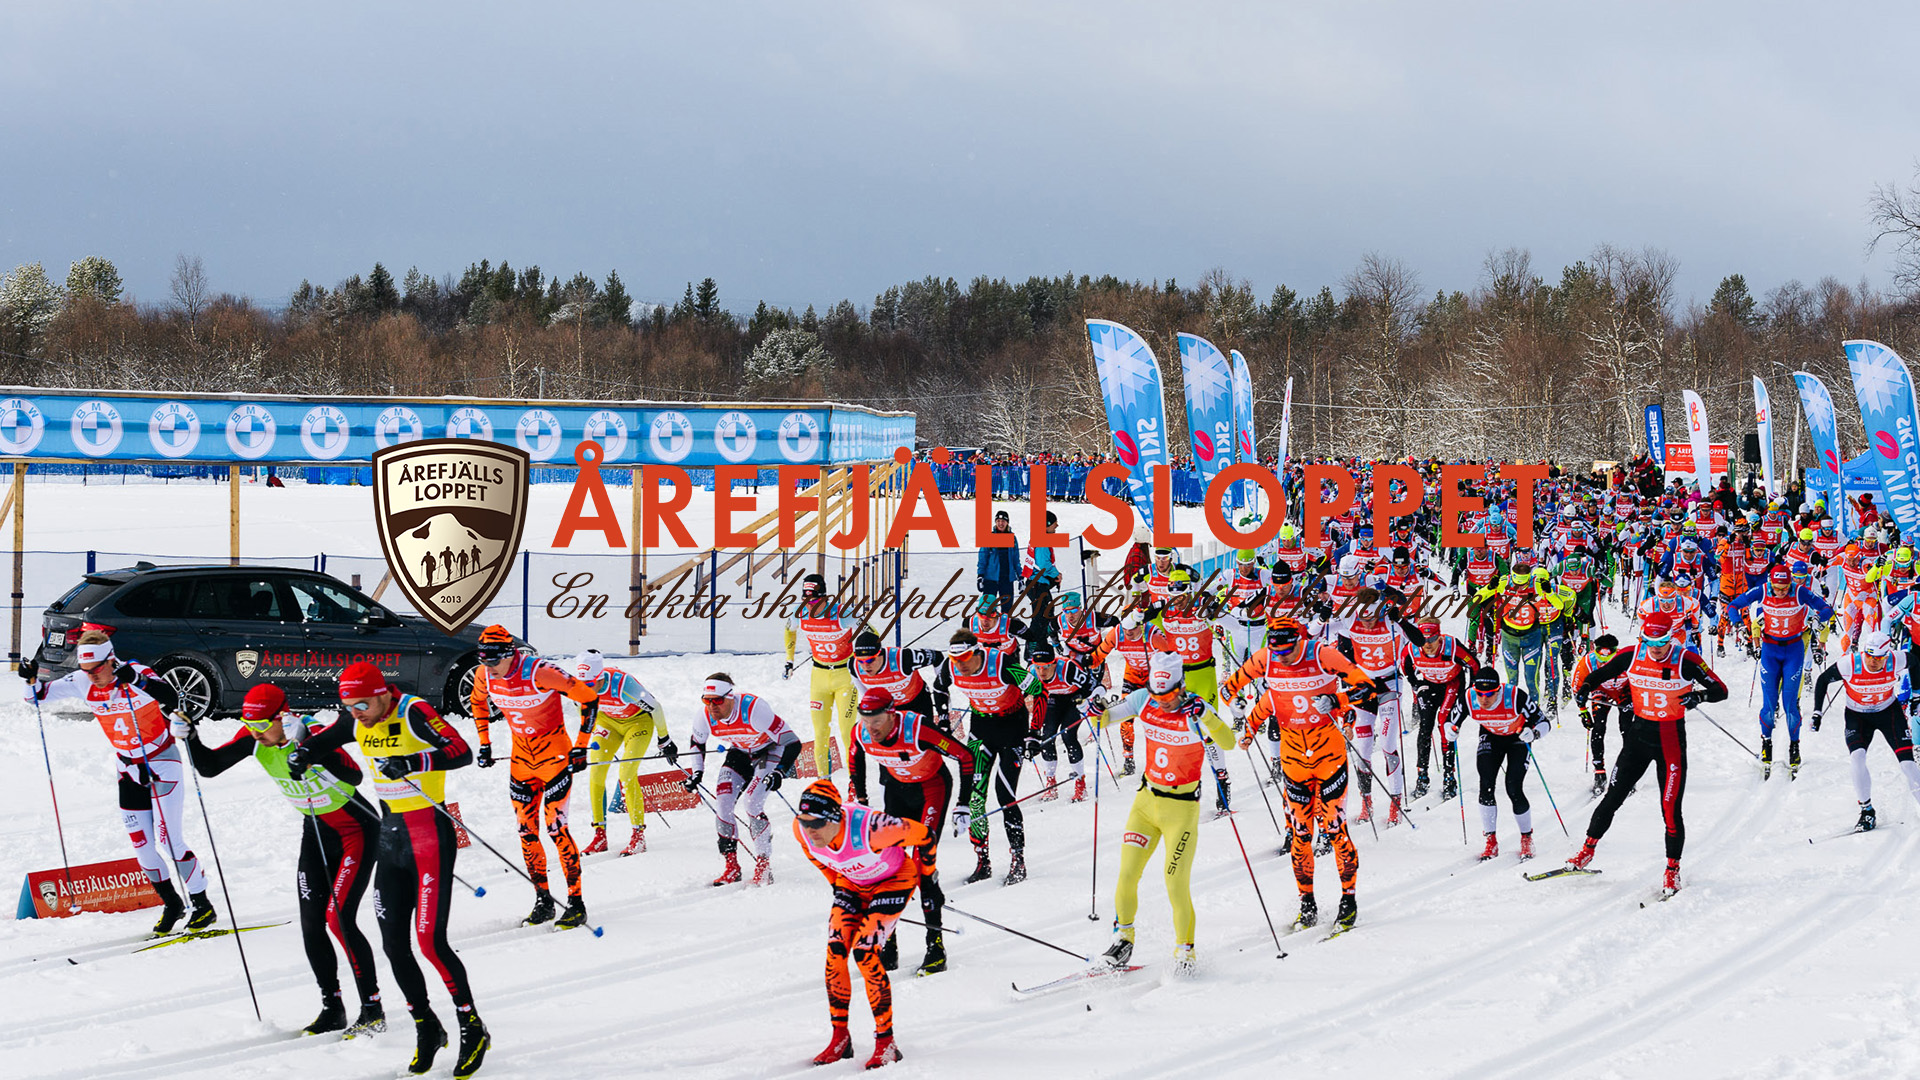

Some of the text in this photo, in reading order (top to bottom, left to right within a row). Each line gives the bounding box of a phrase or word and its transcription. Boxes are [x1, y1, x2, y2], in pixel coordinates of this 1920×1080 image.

[76, 403, 118, 420] BMW
[155, 404, 196, 422] BMW
[231, 407, 272, 423] BMW
[306, 407, 346, 425] BMW
[380, 408, 419, 425] BMW
[451, 409, 488, 426] BMW
[520, 411, 558, 428] BMW
[588, 412, 624, 429] BMW
[654, 412, 690, 430] BMW
[719, 413, 753, 430] BMW
[783, 414, 817, 431] BMW
[1770, 617, 1789, 628] 31
[815, 643, 837, 652] 20
[1175, 636, 1200, 651] 98
[1361, 646, 1385, 660] 24
[1270, 678, 1325, 690] betsson
[1293, 695, 1309, 713] 9
[1641, 692, 1668, 709] 13
[1861, 693, 1884, 702] 21
[113, 717, 129, 735] 4
[509, 711, 526, 724] 2
[363, 735, 399, 748] Hertz
[1155, 747, 1168, 768] 6
[1125, 833, 1146, 844] MENY
[1167, 831, 1191, 876] SKIGO
[58, 871, 148, 897] ÅREFJÄLLSLOPPE
[418, 886, 433, 934] Santander
